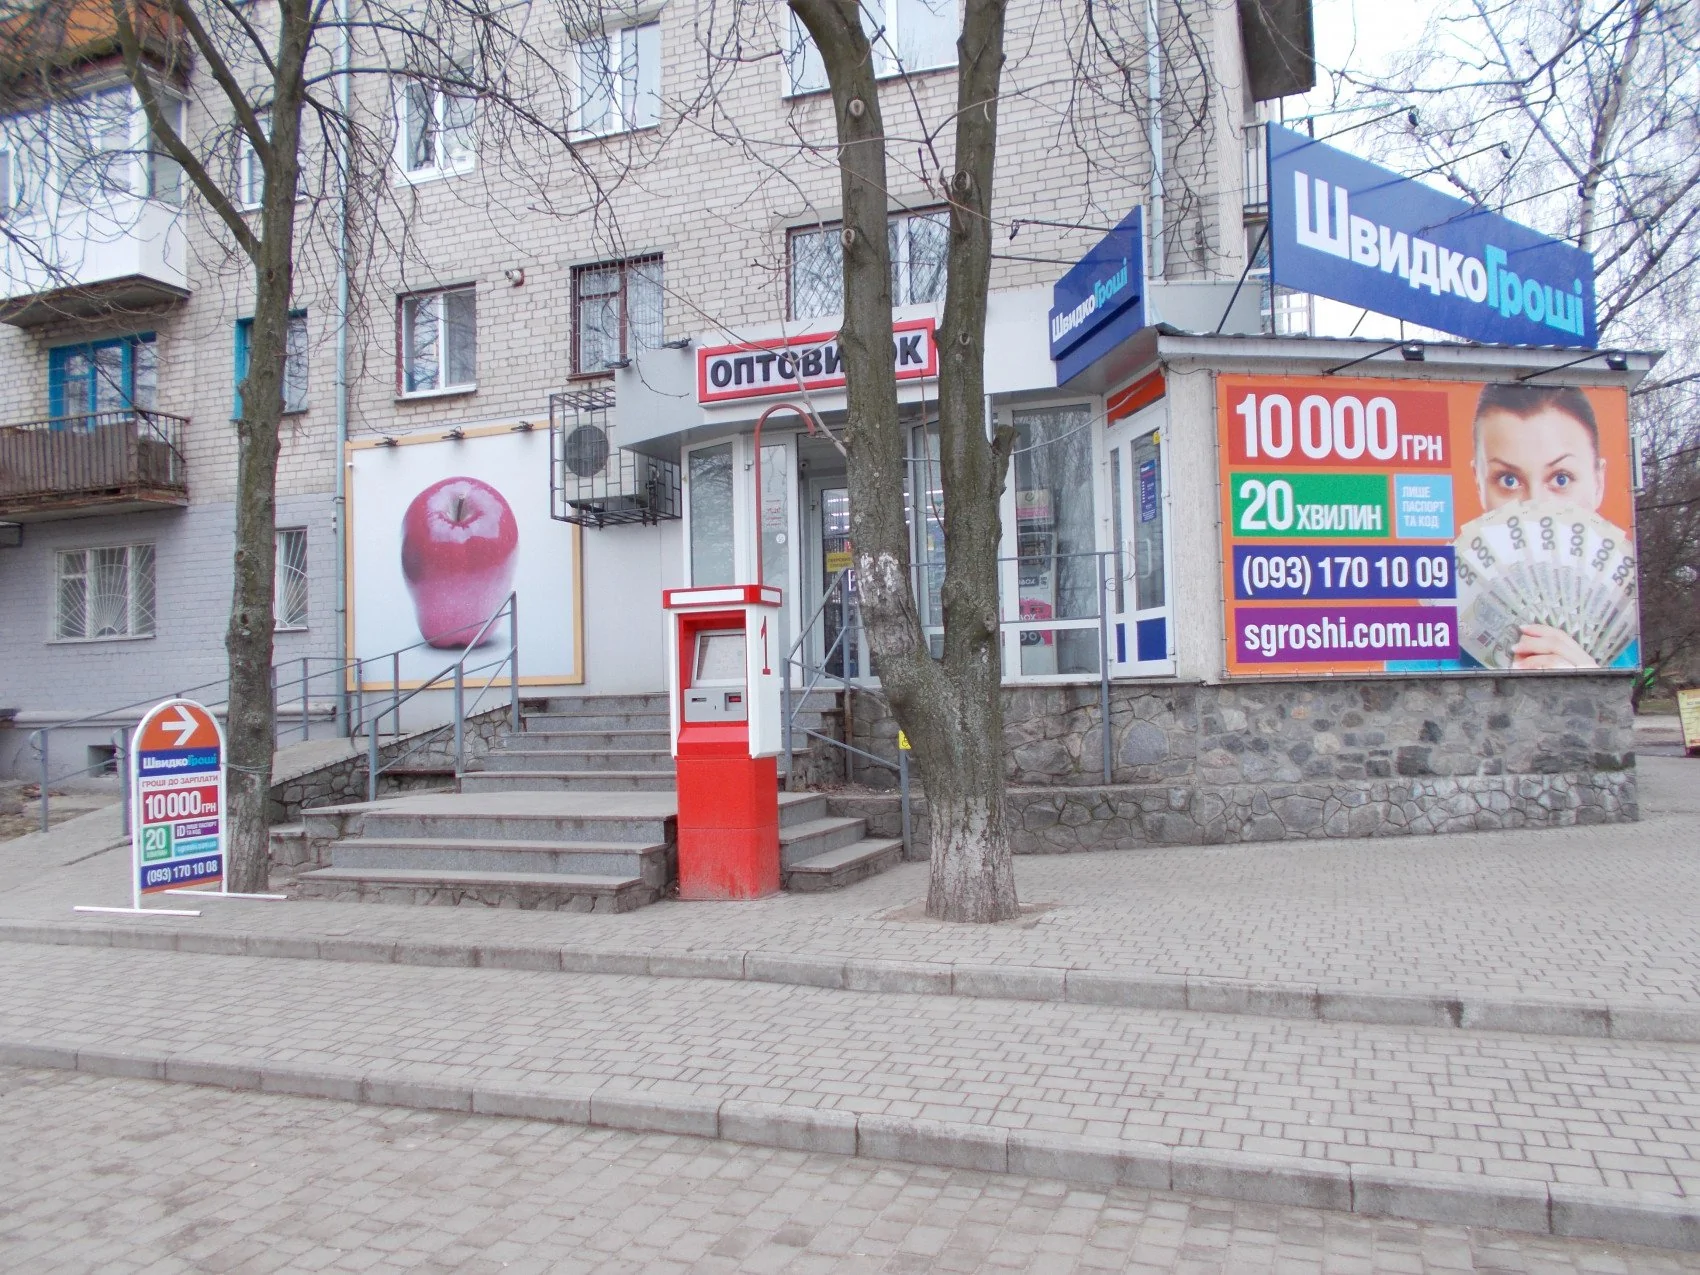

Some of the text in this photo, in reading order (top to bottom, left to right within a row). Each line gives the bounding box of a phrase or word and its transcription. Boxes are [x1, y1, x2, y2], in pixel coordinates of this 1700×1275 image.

[1294, 171, 1585, 337] ШвидкоГроші
[1052, 257, 1128, 343] ШвидкоГроші
[710, 334, 923, 388] ОПТОВИК
[1402, 434, 1443, 461] ГРН
[1402, 486, 1430, 498] ЛИШЕ
[1240, 480, 1382, 531] 20 ХВИЛИН
[1402, 500, 1445, 512] ПАСПОРТ
[1404, 515, 1439, 528] ТА КОД
[1242, 555, 1449, 595] (093) 170 10 09
[1244, 616, 1450, 657] sgroshi.com.ua
[143, 753, 217, 769] ШвидкоГроші
[180, 775, 218, 784] ЗАРПЛАТИ
[201, 803, 217, 813] ГРН
[146, 827, 167, 851] 20
[147, 867, 172, 886] (093)
[173, 864, 191, 878] 170
[193, 862, 205, 874] 10
